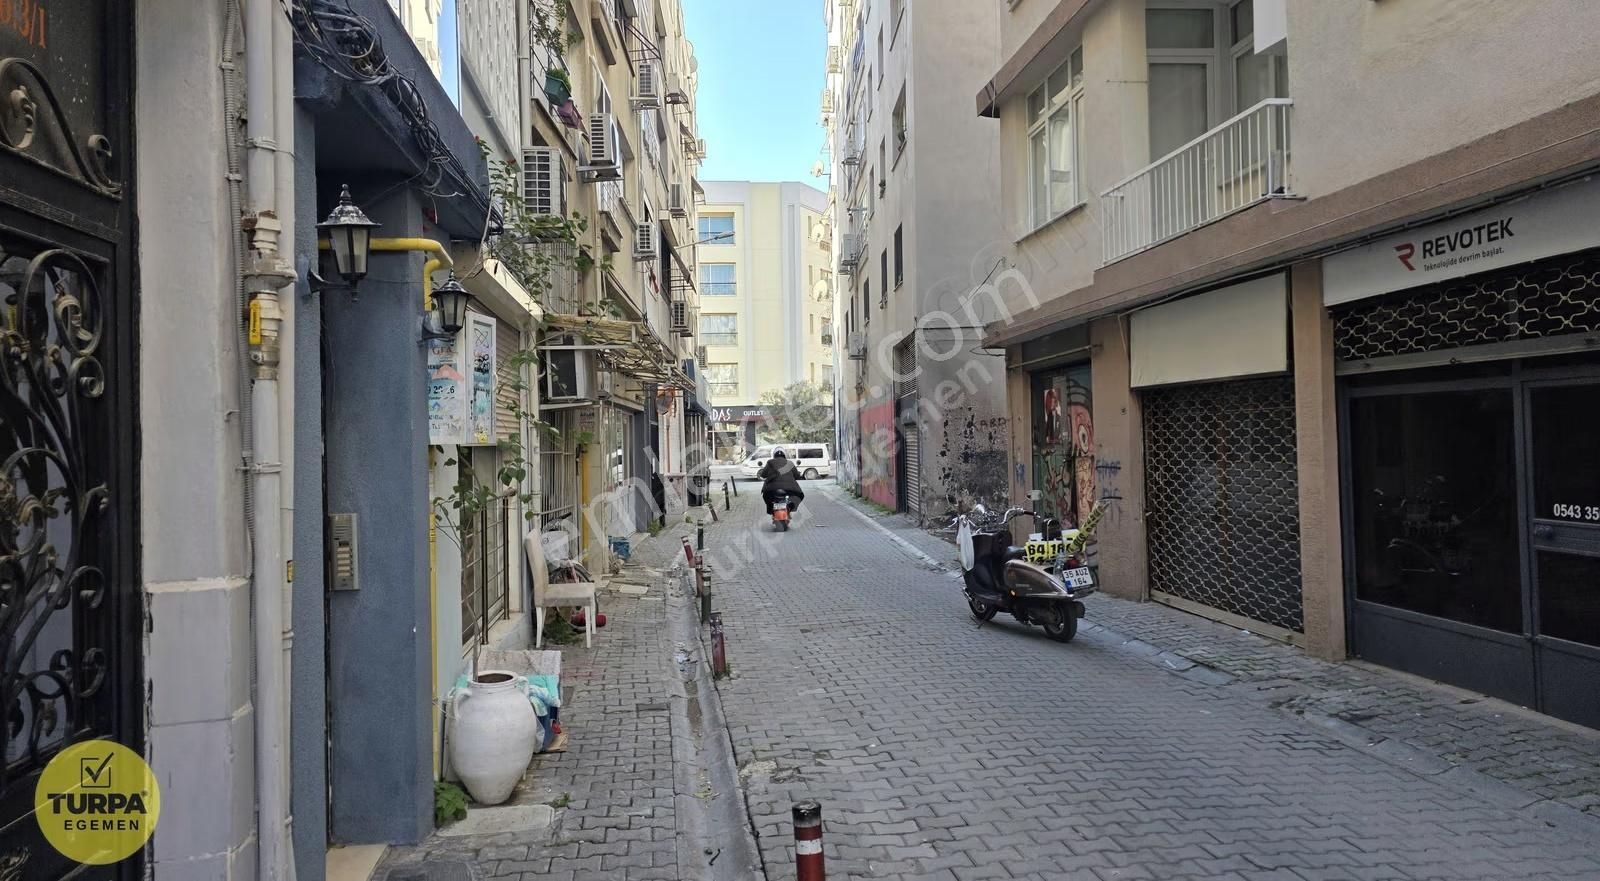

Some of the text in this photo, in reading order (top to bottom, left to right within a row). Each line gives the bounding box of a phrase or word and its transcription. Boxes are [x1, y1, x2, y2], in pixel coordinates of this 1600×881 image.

[1422, 217, 1514, 260] REVOTEK
[1423, 256, 1458, 272] Teknolojide
[1458, 252, 1481, 264] devrim
[1553, 503, 1600, 520] 0543 35
[1064, 567, 1089, 579] 35 AUZ
